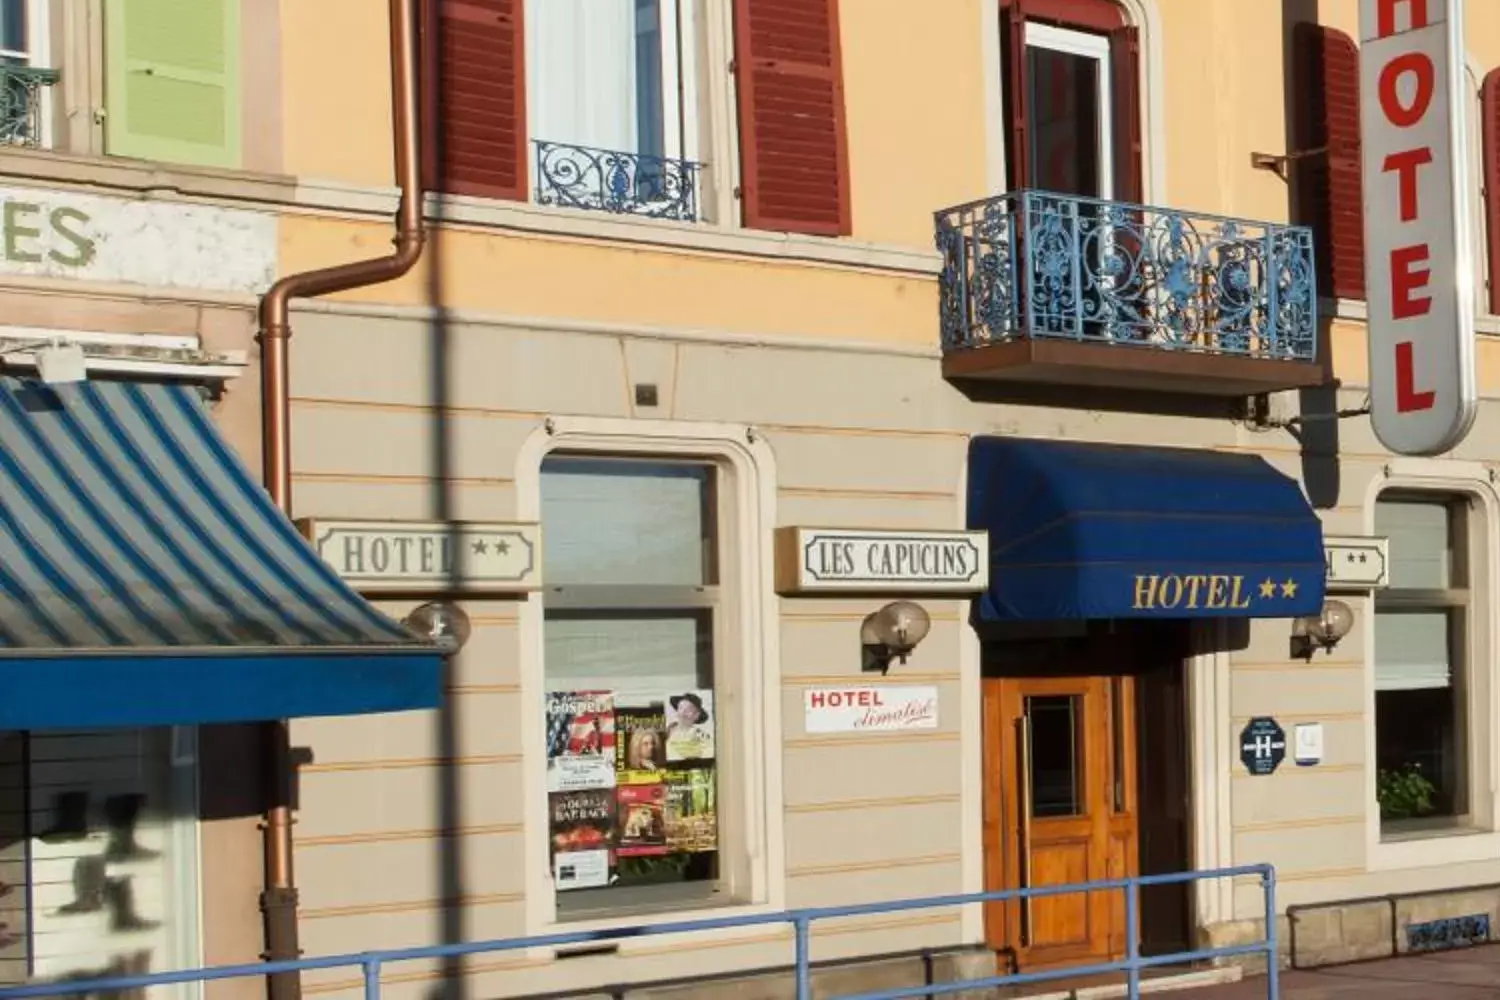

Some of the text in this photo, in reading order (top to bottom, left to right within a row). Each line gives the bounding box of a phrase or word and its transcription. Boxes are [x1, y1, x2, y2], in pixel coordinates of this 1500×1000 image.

[3, 201, 96, 267] ES
[343, 536, 453, 573] HOTEL
[819, 542, 967, 575] LES CAPUCINS
[1132, 575, 1250, 609] HOTEL
[811, 691, 884, 708] HOTEL
